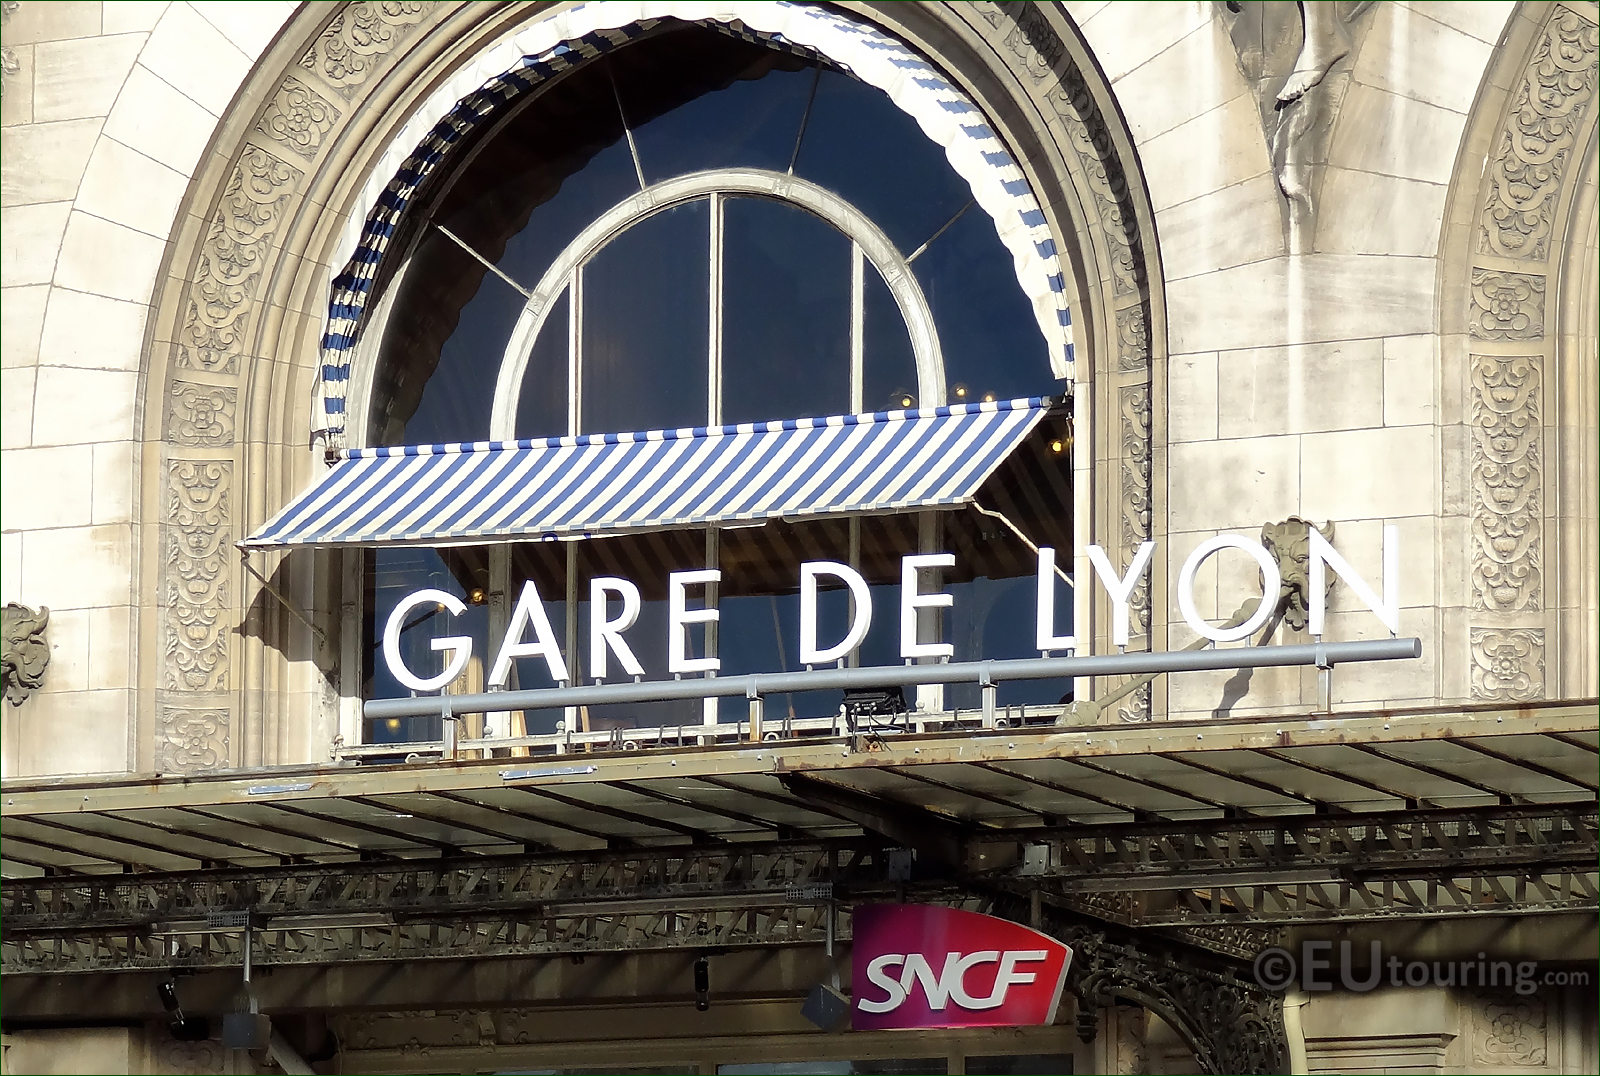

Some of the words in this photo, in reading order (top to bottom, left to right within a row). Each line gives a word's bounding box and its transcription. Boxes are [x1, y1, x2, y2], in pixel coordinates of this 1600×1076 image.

[383, 569, 722, 692] GARE
[800, 553, 956, 664] DE
[1036, 524, 1400, 650] LYON
[857, 950, 1048, 1013] SNCF
